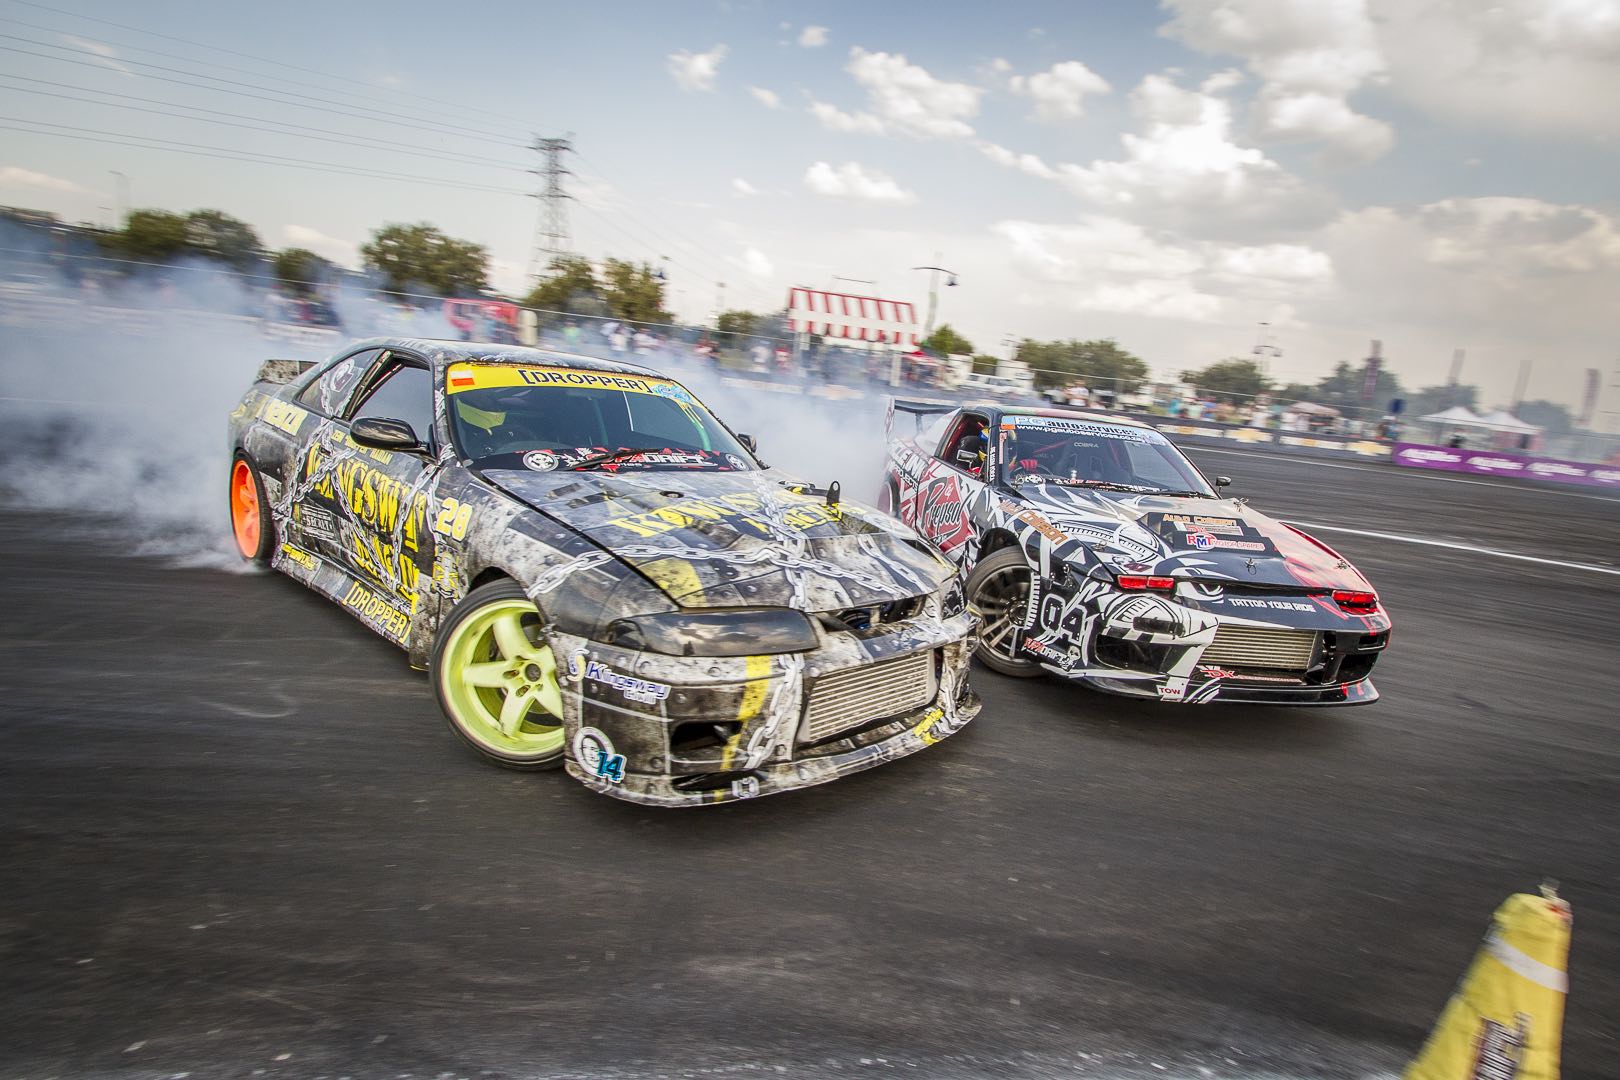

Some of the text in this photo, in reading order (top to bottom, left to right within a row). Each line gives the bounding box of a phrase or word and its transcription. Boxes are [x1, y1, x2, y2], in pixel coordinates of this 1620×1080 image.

[1073, 441, 1100, 449] COBRA
[435, 497, 474, 542] 28
[1228, 598, 1317, 613] TATTOO YOUR RIDE
[1159, 687, 1181, 695] TOW
[597, 751, 624, 781] 14
